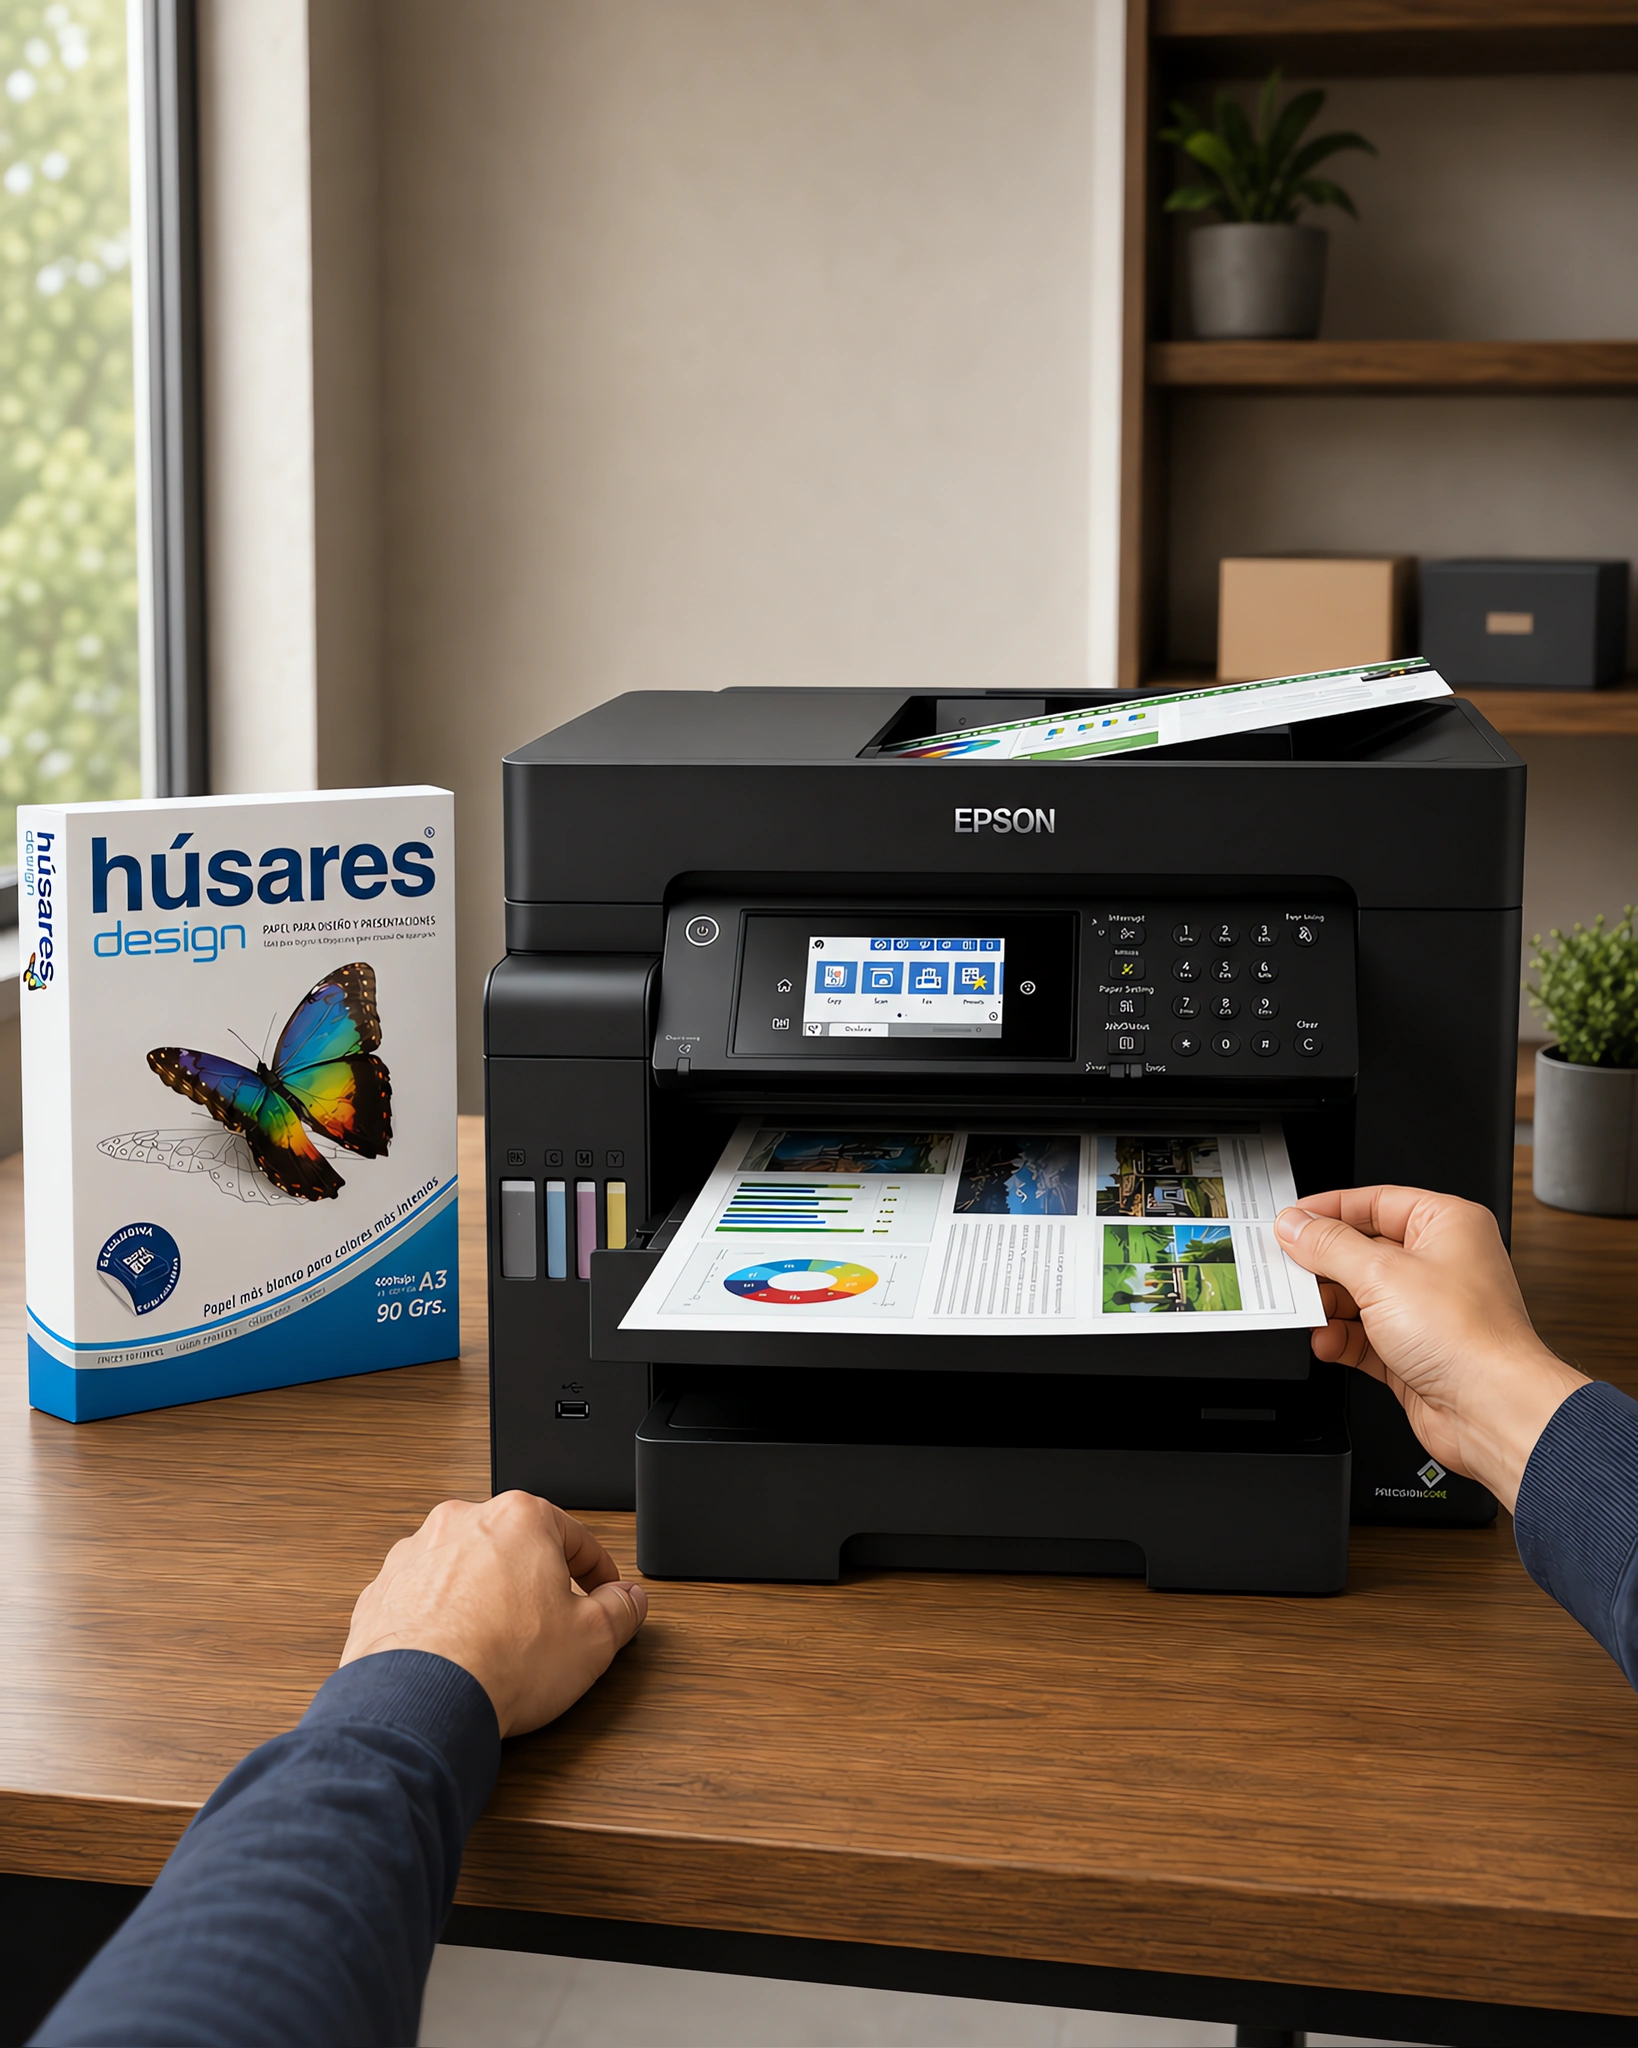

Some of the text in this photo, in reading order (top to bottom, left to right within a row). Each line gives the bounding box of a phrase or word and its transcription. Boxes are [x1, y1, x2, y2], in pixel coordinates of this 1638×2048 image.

[954, 807, 1055, 833] EPSON
[91, 832, 437, 914] húsares
[37, 831, 56, 982] húsares
[93, 920, 246, 964] design
[1221, 924, 1230, 936] 2
[1260, 924, 1268, 936] 3
[1221, 961, 1230, 972] 5
[1260, 961, 1269, 972] 6
[1181, 997, 1270, 1009] 7 8 9
[1303, 1037, 1314, 1051] C
[418, 1269, 448, 1292] A3
[376, 1298, 447, 1323] 90 Grs.
